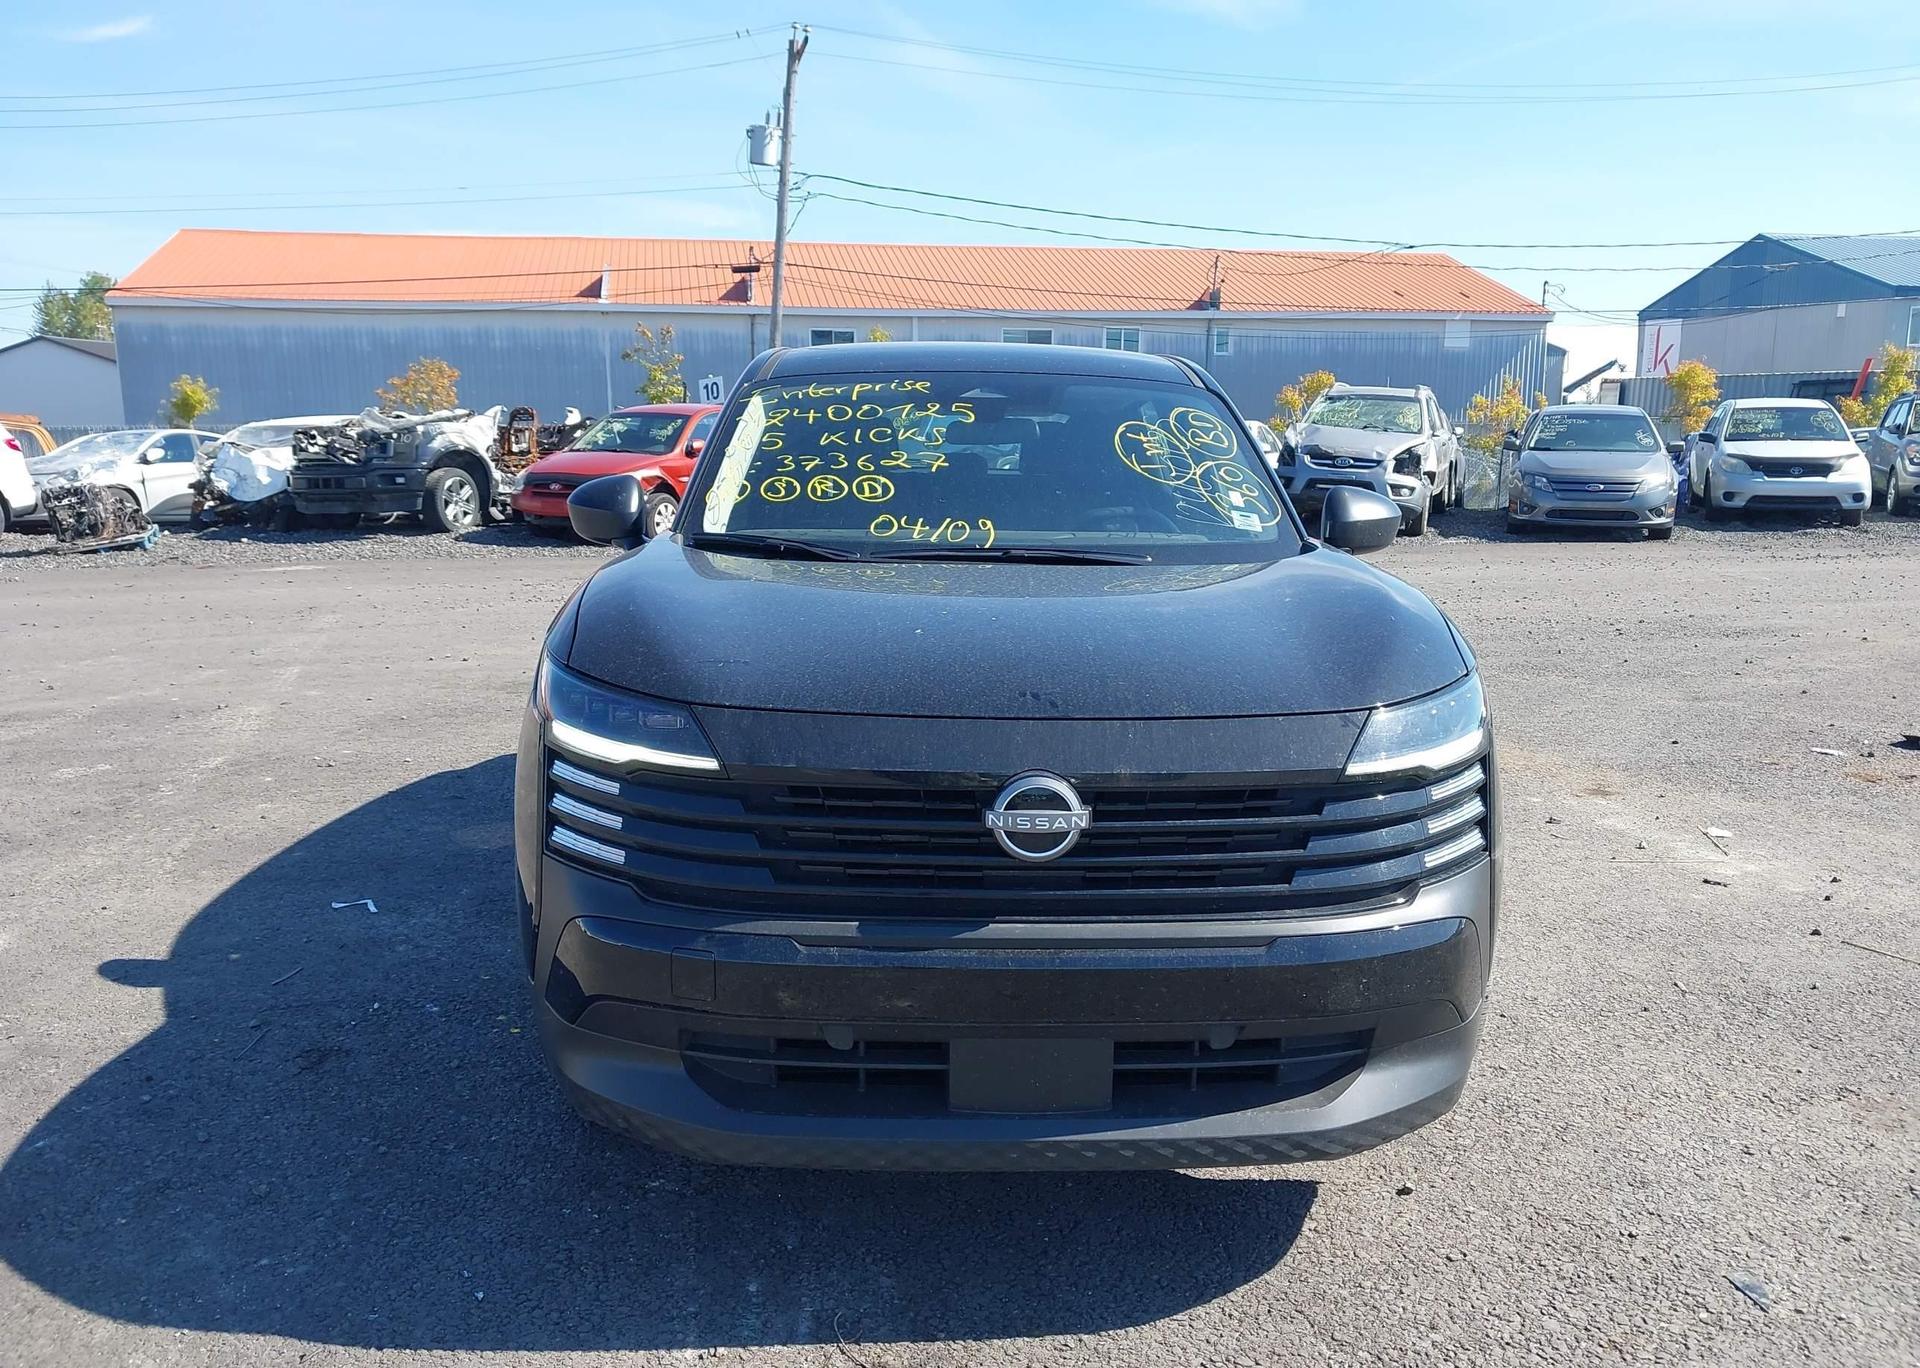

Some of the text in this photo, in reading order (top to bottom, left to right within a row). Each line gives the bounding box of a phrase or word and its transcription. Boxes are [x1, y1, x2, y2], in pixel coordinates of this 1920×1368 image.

[702, 381, 720, 401] 10
[820, 428, 947, 446] KICKS
[776, 451, 950, 473] 373627
[988, 814, 1087, 830] NISSAN
